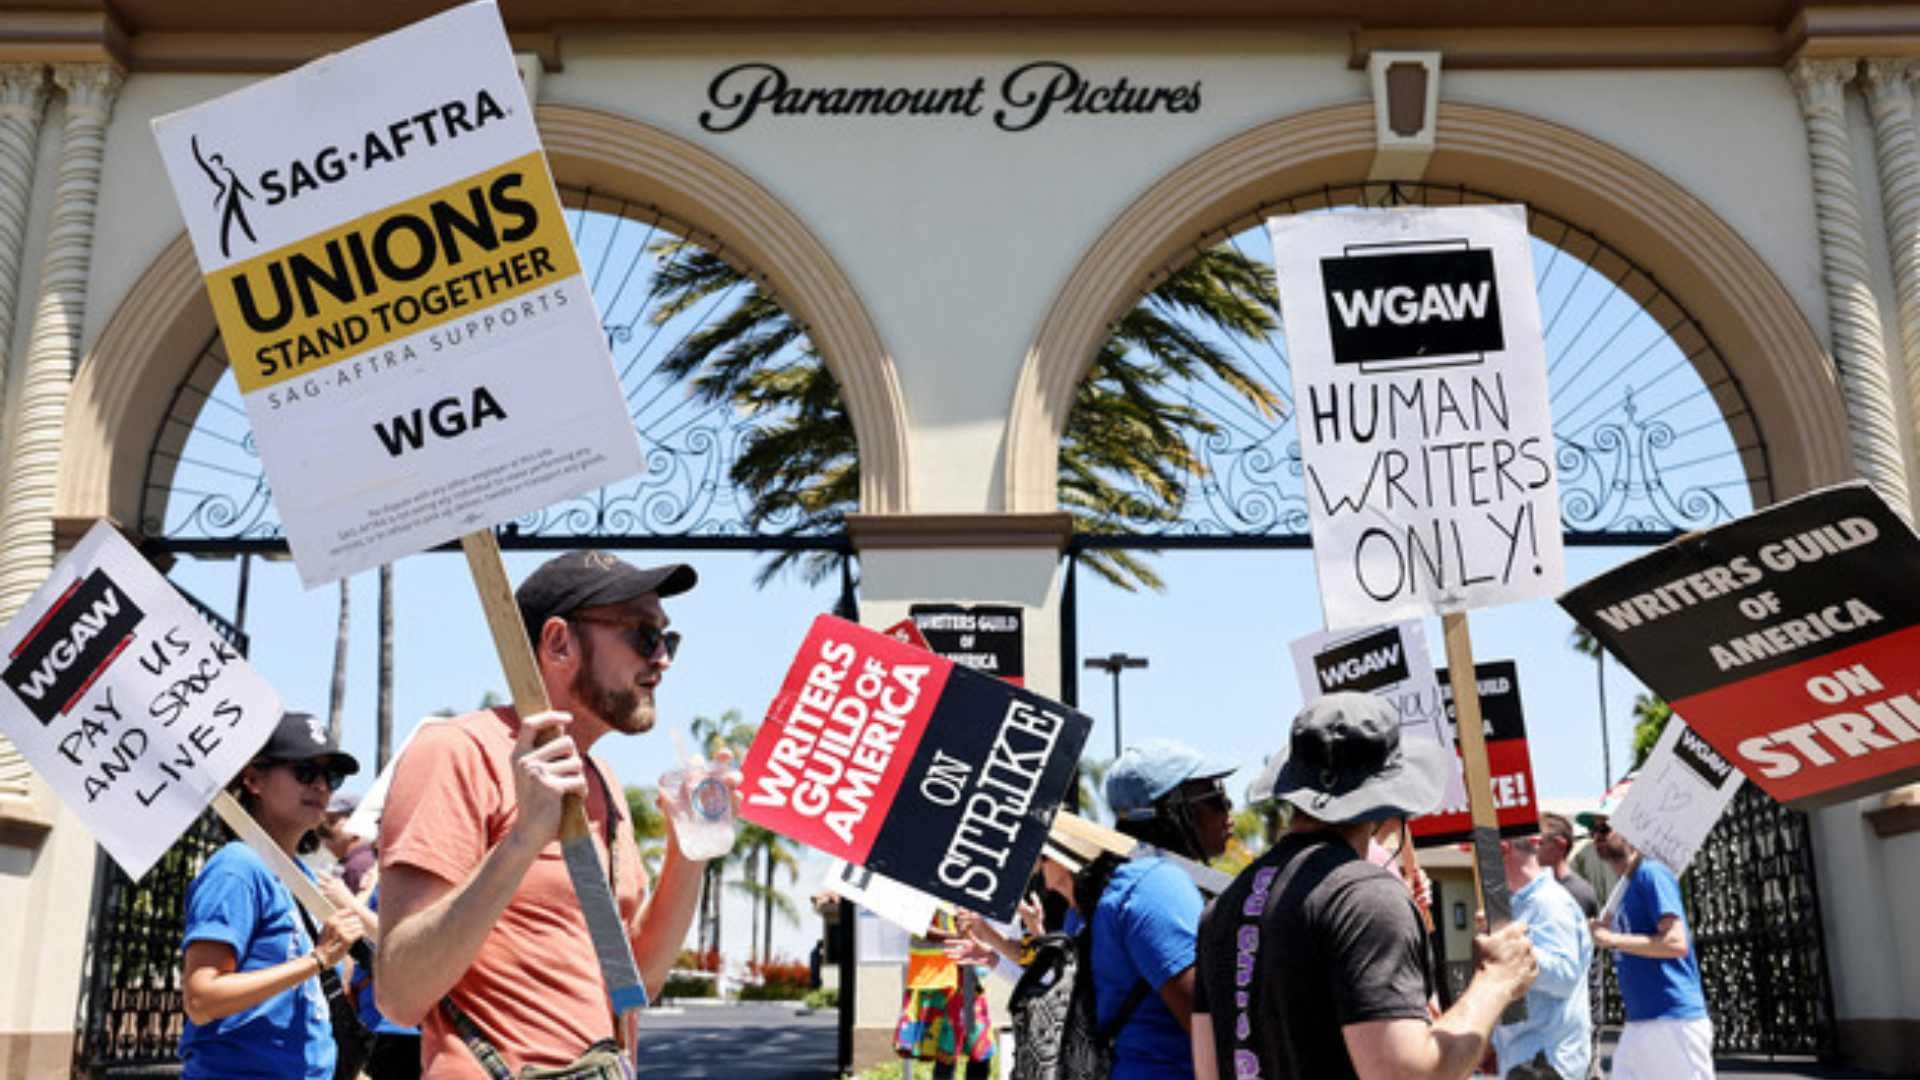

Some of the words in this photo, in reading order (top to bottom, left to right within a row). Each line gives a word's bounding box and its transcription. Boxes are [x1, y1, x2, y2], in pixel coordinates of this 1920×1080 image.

[699, 62, 985, 132] Paramount
[993, 60, 1202, 131] Pictures
[231, 172, 538, 334] UNIONS
[256, 314, 369, 378] STAND
[371, 246, 556, 334] TOGETHER
[430, 289, 569, 353] SUPPORTS
[1332, 281, 1490, 328] WGAW
[374, 386, 507, 458] WGA
[1309, 372, 1510, 445] HUMAN
[1307, 437, 1550, 516] WRITERS
[1355, 501, 1543, 602] ONLY!
[1596, 555, 1763, 633] WRITERS
[1757, 517, 1879, 572] GUILD
[914, 613, 977, 631] WRITERS
[978, 613, 1019, 632] GUILD
[959, 634, 976, 649] OF
[1708, 597, 1884, 672] AMERICA
[1738, 590, 1781, 620] OF
[18, 587, 121, 700] WGAW
[938, 652, 998, 670] ERICA
[1320, 643, 1400, 688] WGAW
[58, 686, 123, 766] PAY
[140, 625, 193, 676] US
[1805, 663, 1885, 705] ON
[135, 699, 244, 807] LIVES
[748, 639, 857, 808] WRITERS
[792, 700, 869, 816] GUILD
[855, 656, 888, 701] OF
[823, 663, 931, 844] AMERICA
[84, 728, 148, 803] AND
[919, 750, 974, 806] ON
[938, 699, 1065, 901] STRIKE
